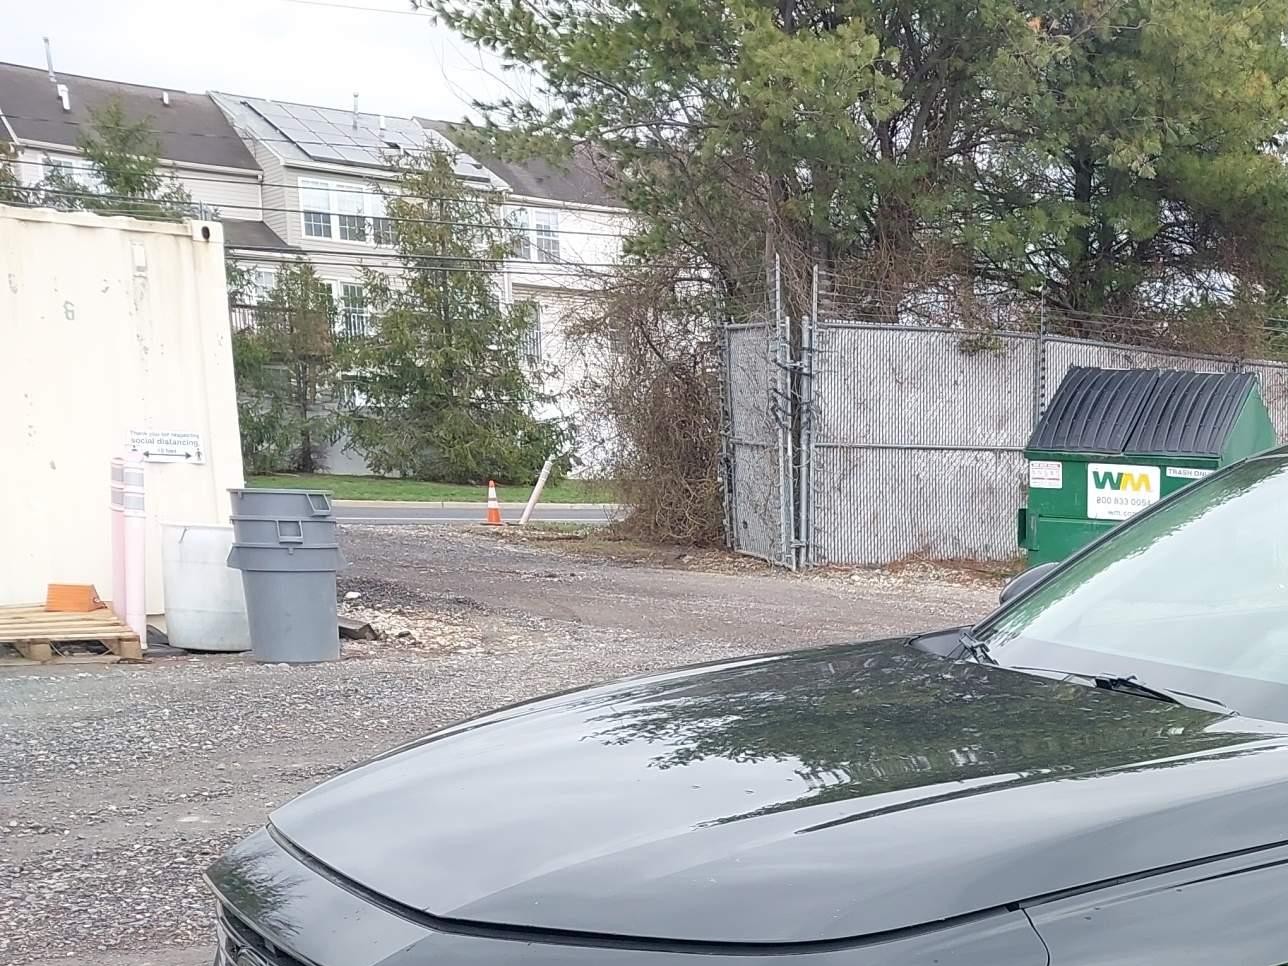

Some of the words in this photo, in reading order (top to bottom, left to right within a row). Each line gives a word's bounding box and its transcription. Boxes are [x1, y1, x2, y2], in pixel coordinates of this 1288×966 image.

[131, 437, 155, 445] social
[156, 438, 199, 447] distancing
[1168, 468, 1193, 477] TRASH
[1092, 470, 1152, 493] WM
